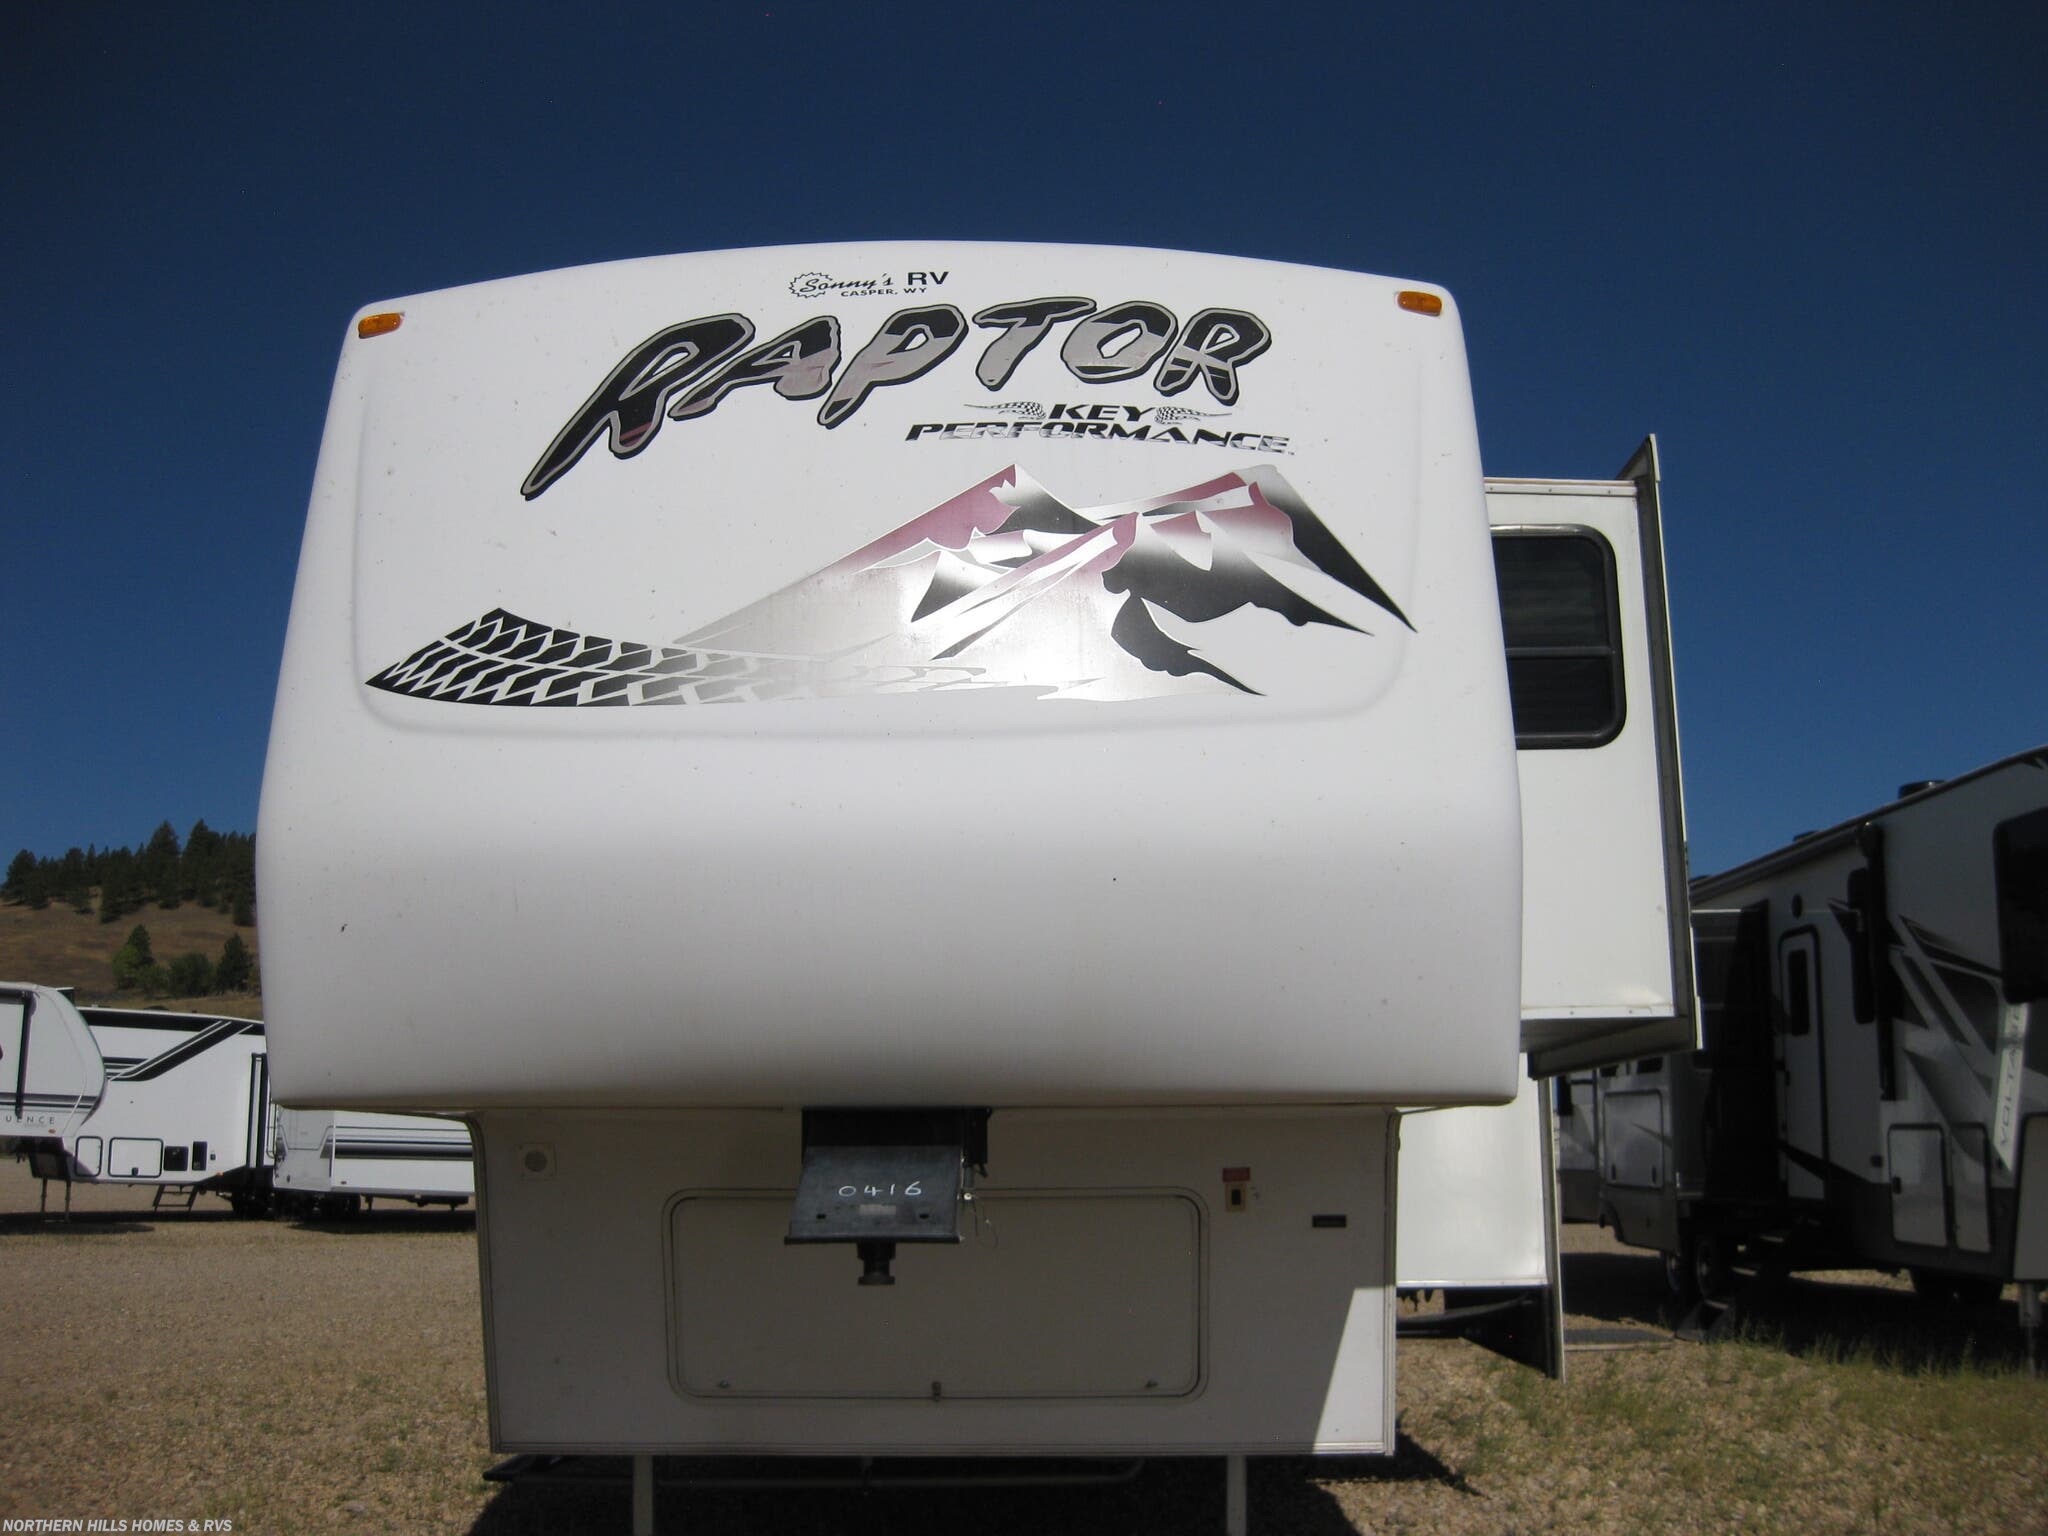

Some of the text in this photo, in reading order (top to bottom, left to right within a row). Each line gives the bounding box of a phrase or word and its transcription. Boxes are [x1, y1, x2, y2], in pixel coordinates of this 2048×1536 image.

[799, 271, 949, 293] Sonny's RV
[840, 288, 899, 297] CASPER,
[519, 298, 1273, 501] RAPTOR
[1048, 403, 1157, 422] KEY
[905, 420, 1291, 455] PERFORMANCE
[838, 1180, 923, 1197] 0416
